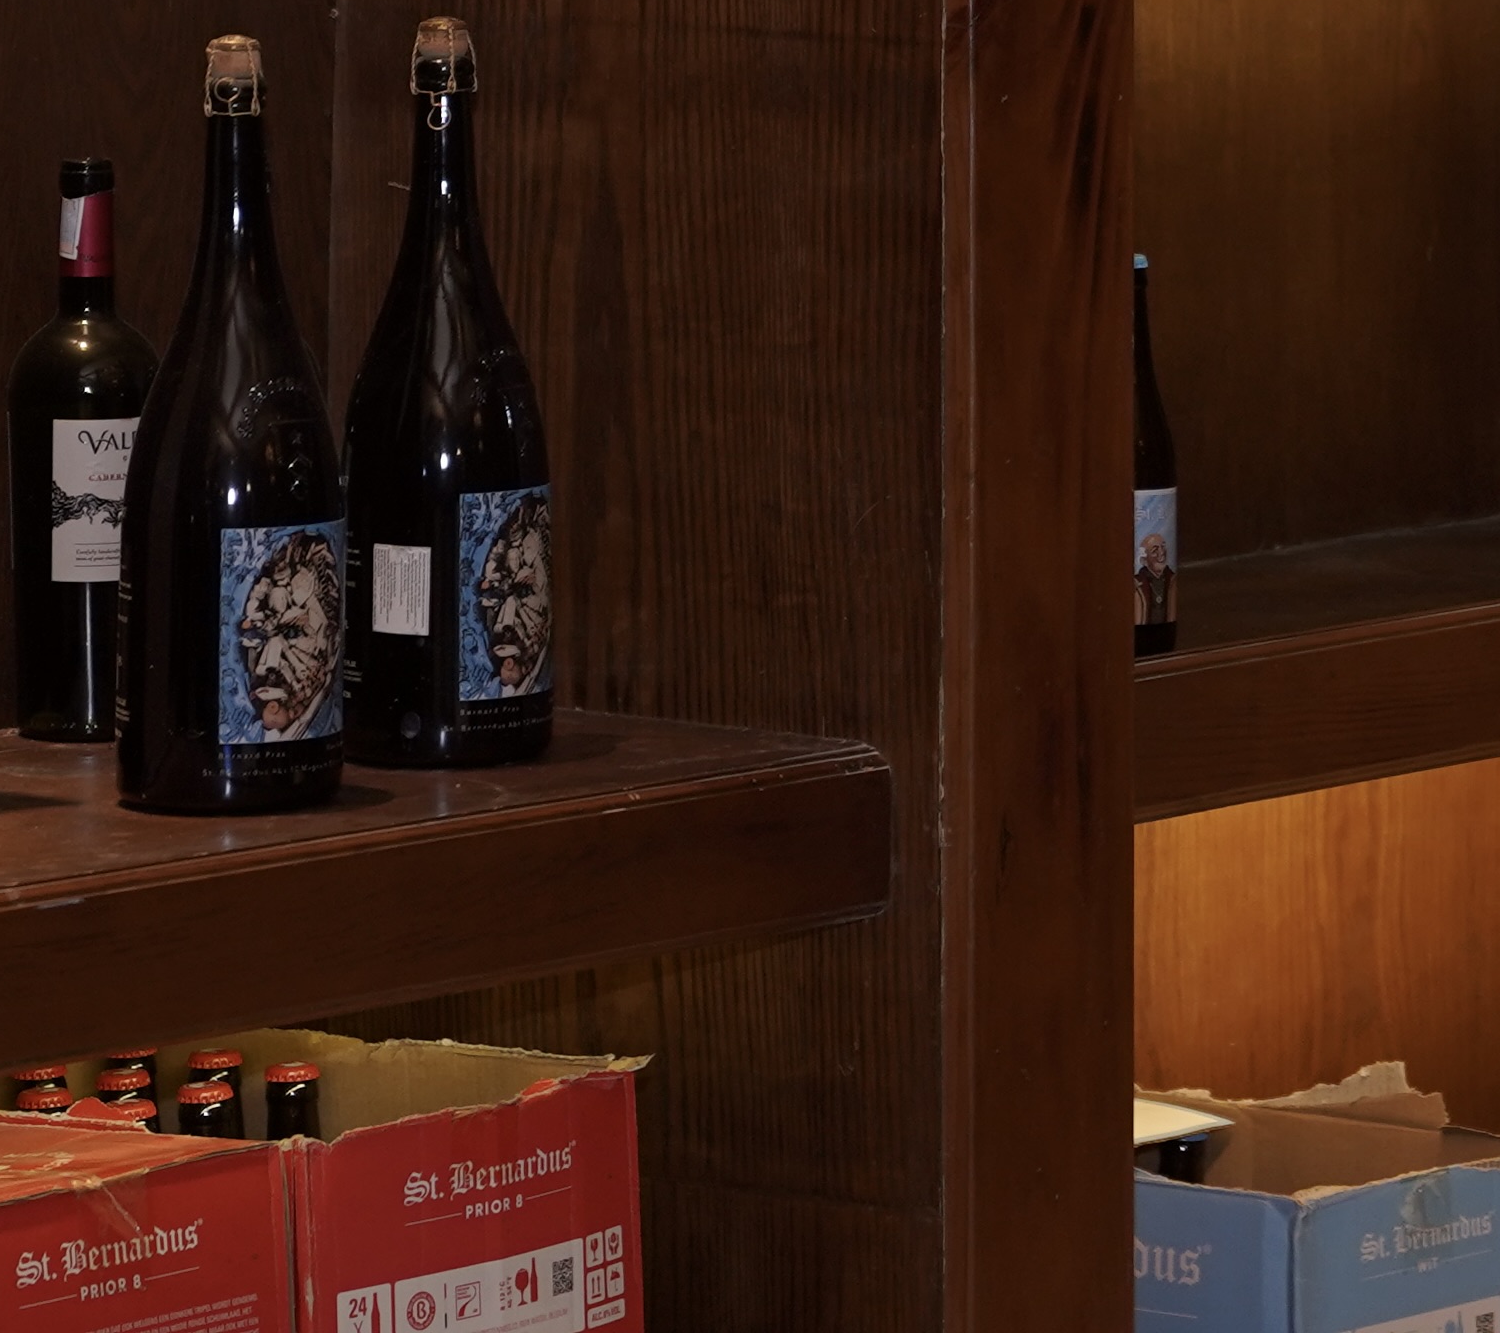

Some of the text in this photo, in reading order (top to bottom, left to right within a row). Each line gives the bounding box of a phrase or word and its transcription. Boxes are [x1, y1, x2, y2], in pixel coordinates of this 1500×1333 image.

[404, 1145, 572, 1207] St. Bernardus
[466, 1194, 523, 1220] PRIOR 8
[16, 1221, 200, 1289] St. Bernardus
[1360, 1214, 1492, 1263] St. Bernardus
[80, 1274, 142, 1301] PRIOR 8
[349, 1297, 367, 1318] 24
